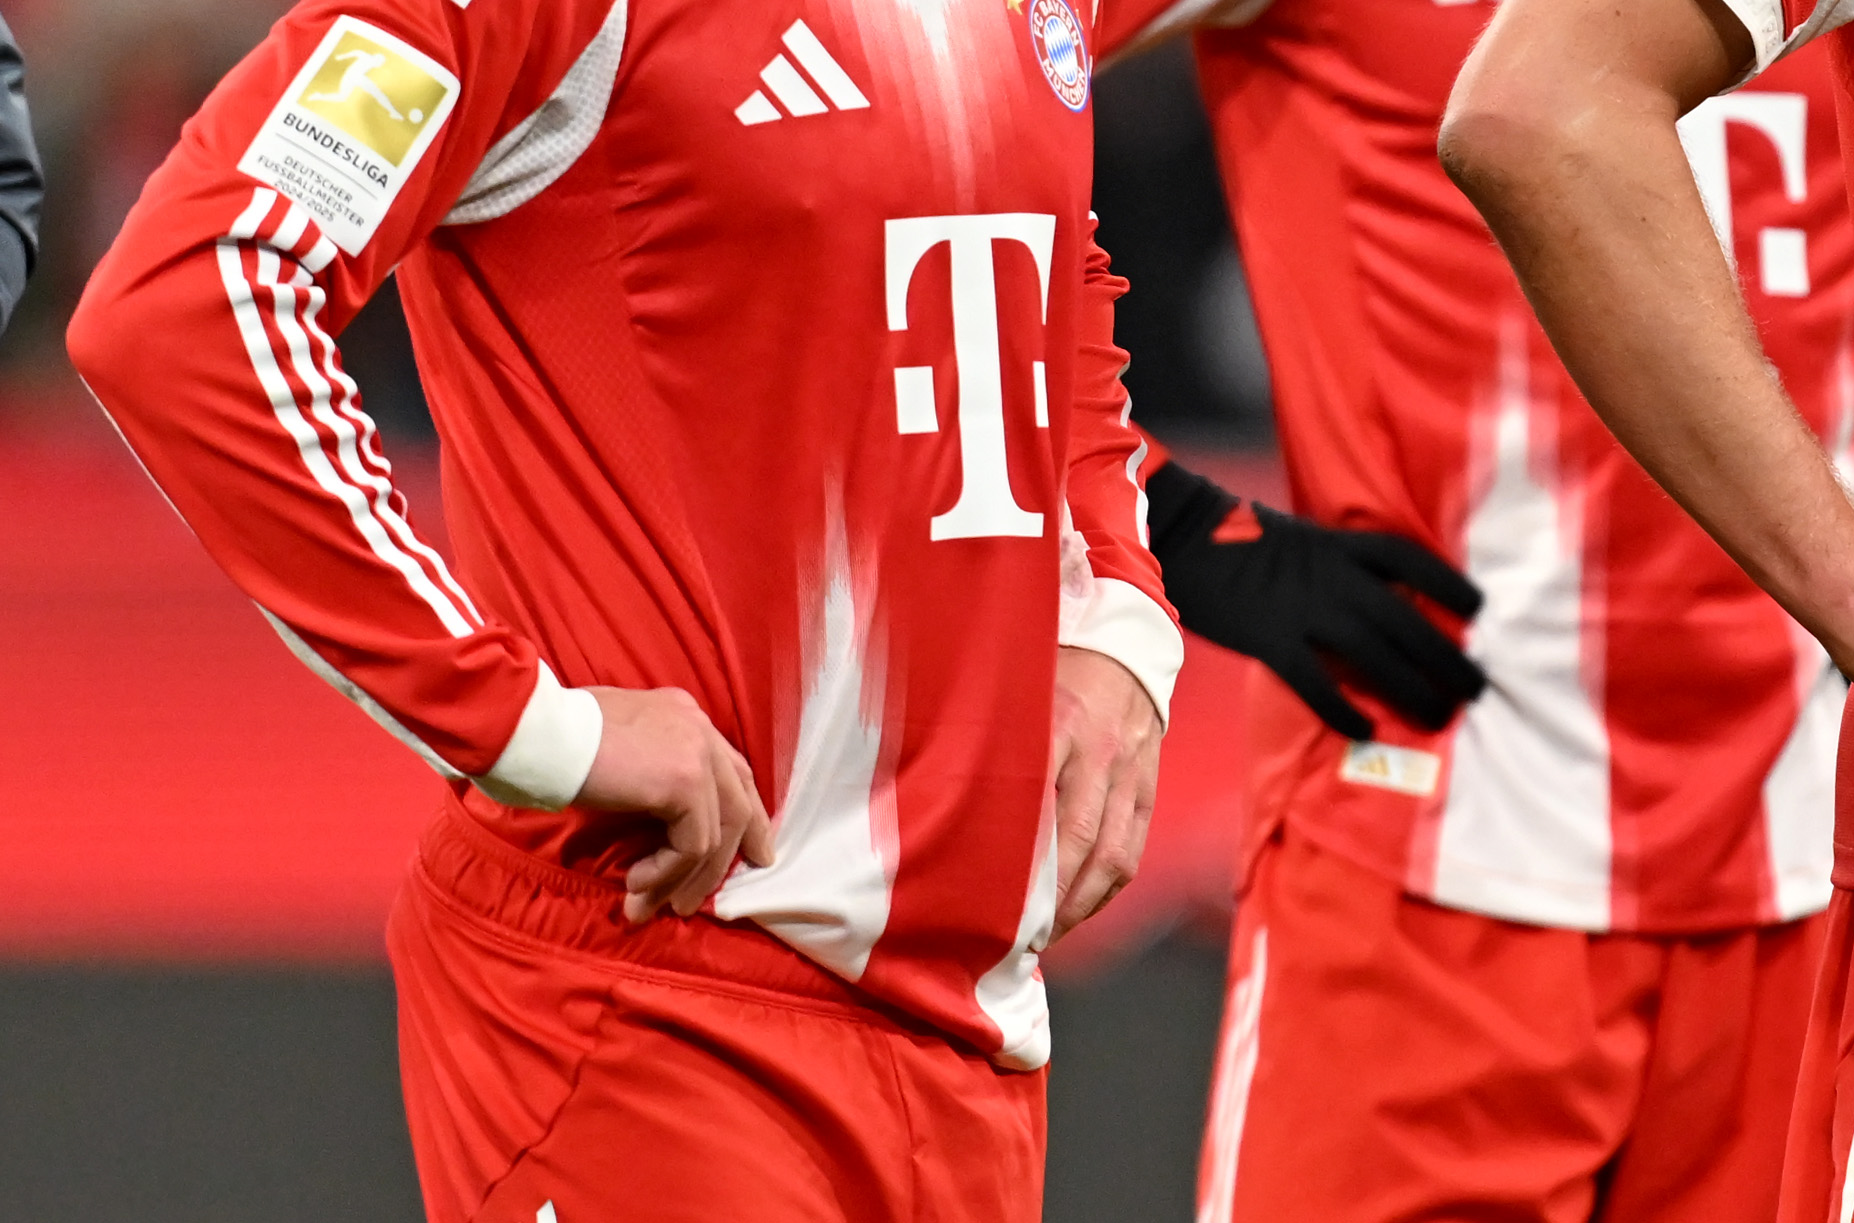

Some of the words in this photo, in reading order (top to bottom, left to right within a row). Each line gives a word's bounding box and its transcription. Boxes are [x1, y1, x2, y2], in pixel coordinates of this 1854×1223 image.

[1033, 12, 1044, 38] FC
[1039, 0, 1079, 46] BAYERN
[283, 113, 389, 188] BUNDESLIGA
[284, 155, 353, 203] DEUTSCHER
[257, 155, 365, 227] FUSSBALLMEISTER
[274, 179, 335, 223] 2024/2025
[885, 212, 1056, 541] T
